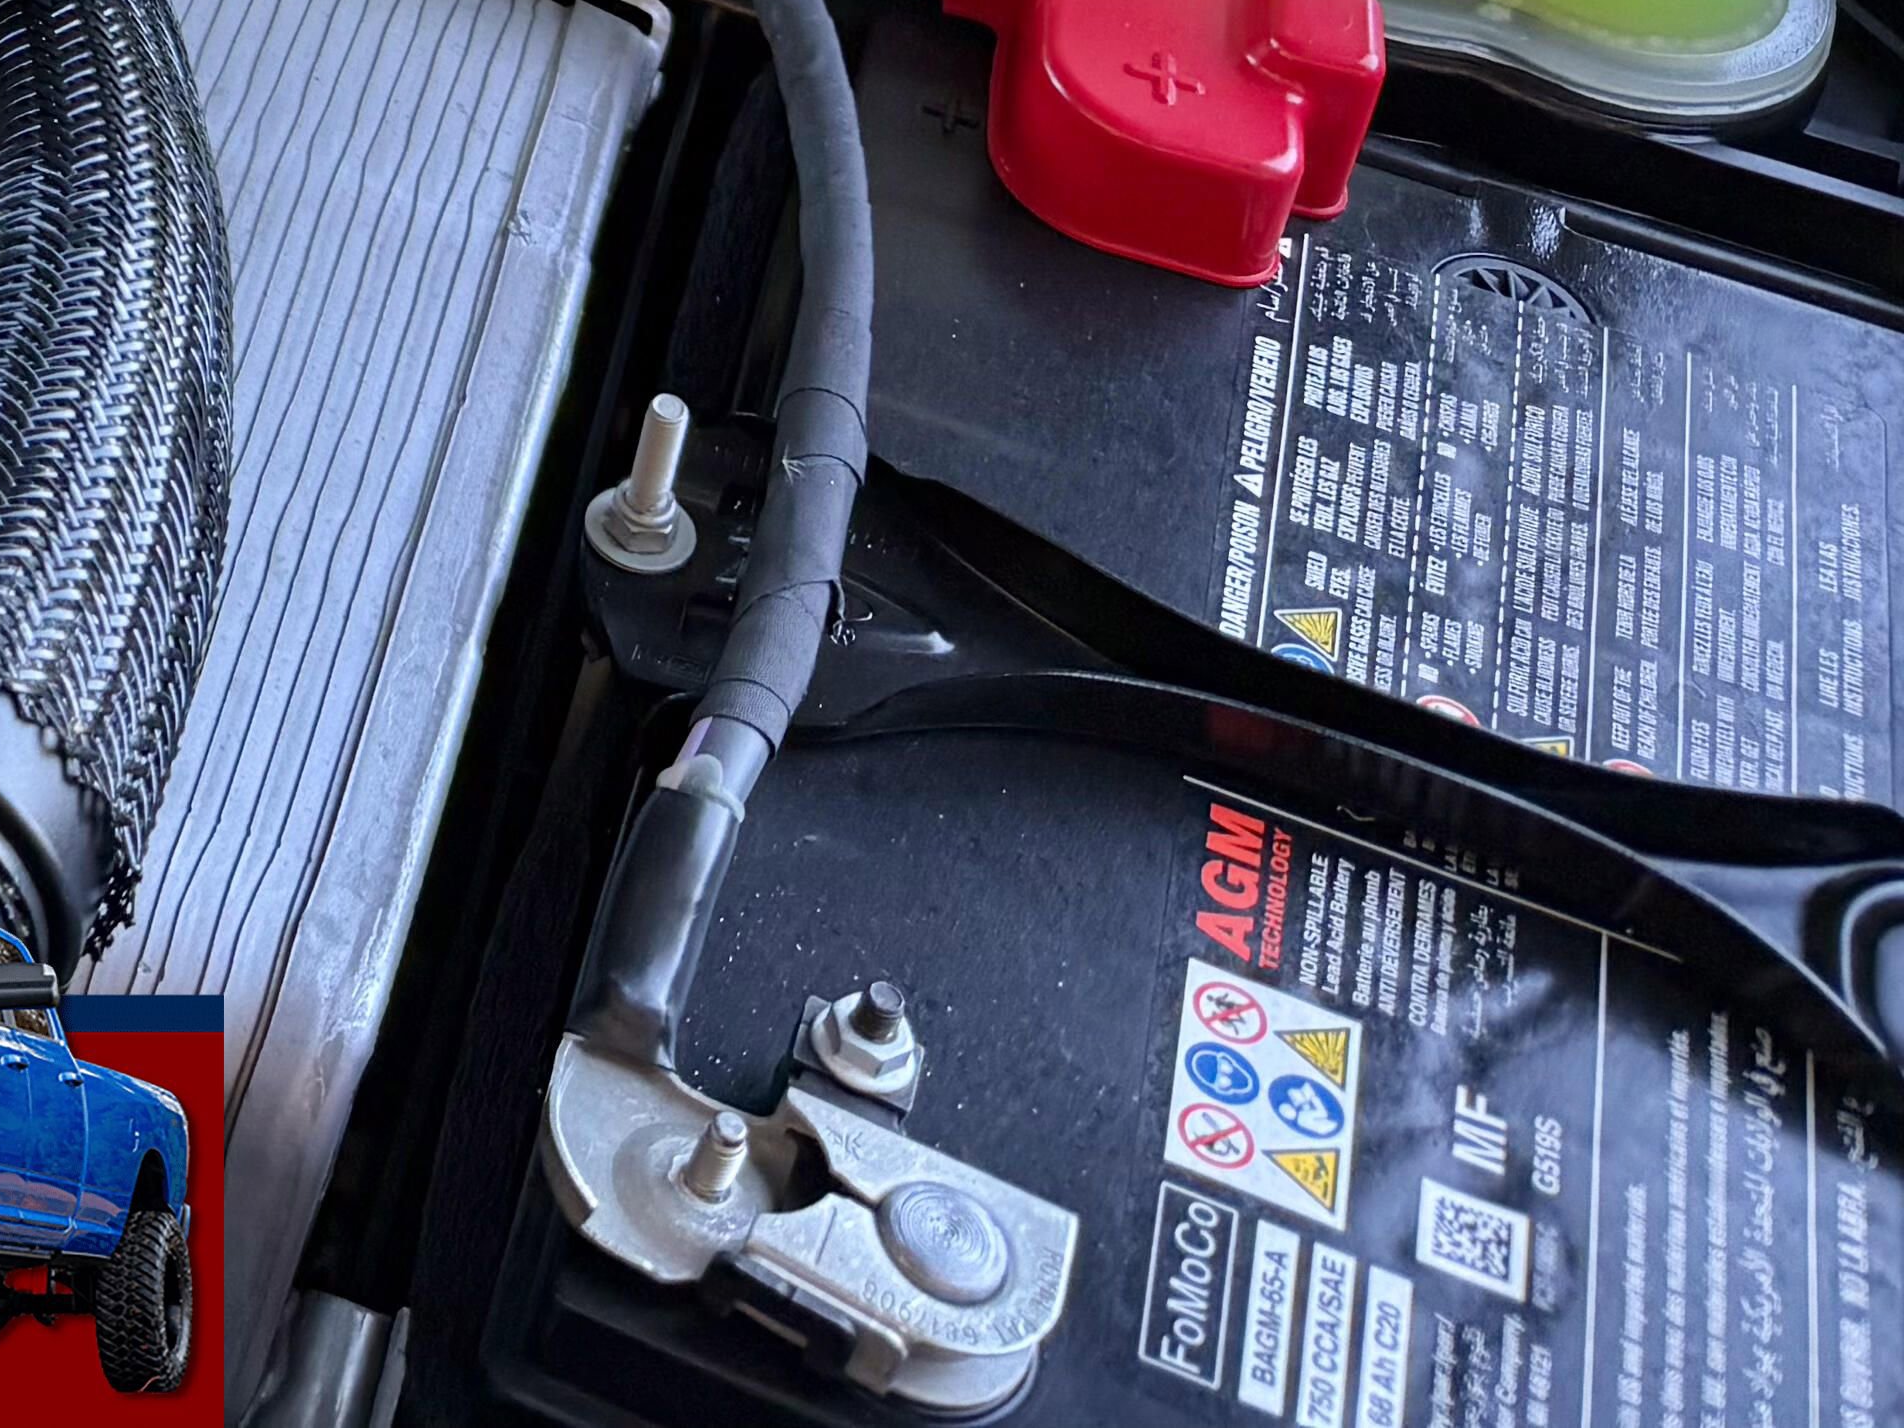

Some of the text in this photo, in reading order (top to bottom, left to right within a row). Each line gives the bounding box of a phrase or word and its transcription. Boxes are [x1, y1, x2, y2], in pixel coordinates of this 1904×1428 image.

[1219, 332, 1281, 639] DANGER/POISON PELIGRO/VENENO
[1195, 798, 1266, 963] AGM
[1257, 825, 1295, 974] TECHNOLOGY
[1298, 851, 1330, 987] NON-SPILLABLE
[1322, 855, 1354, 995] Lead Acid Battery
[1363, 868, 1387, 923] plomb
[1352, 940, 1376, 1006] Batterie
[1452, 1084, 1508, 1176] MF
[1532, 1115, 1563, 1196] G519S
[1158, 1192, 1220, 1374] FoMoCo
[1251, 1244, 1288, 1387] BAGM-65-A
[1306, 1254, 1347, 1426] 750 CCA/SAE
[1368, 1298, 1401, 1428] 68 Ah C20
